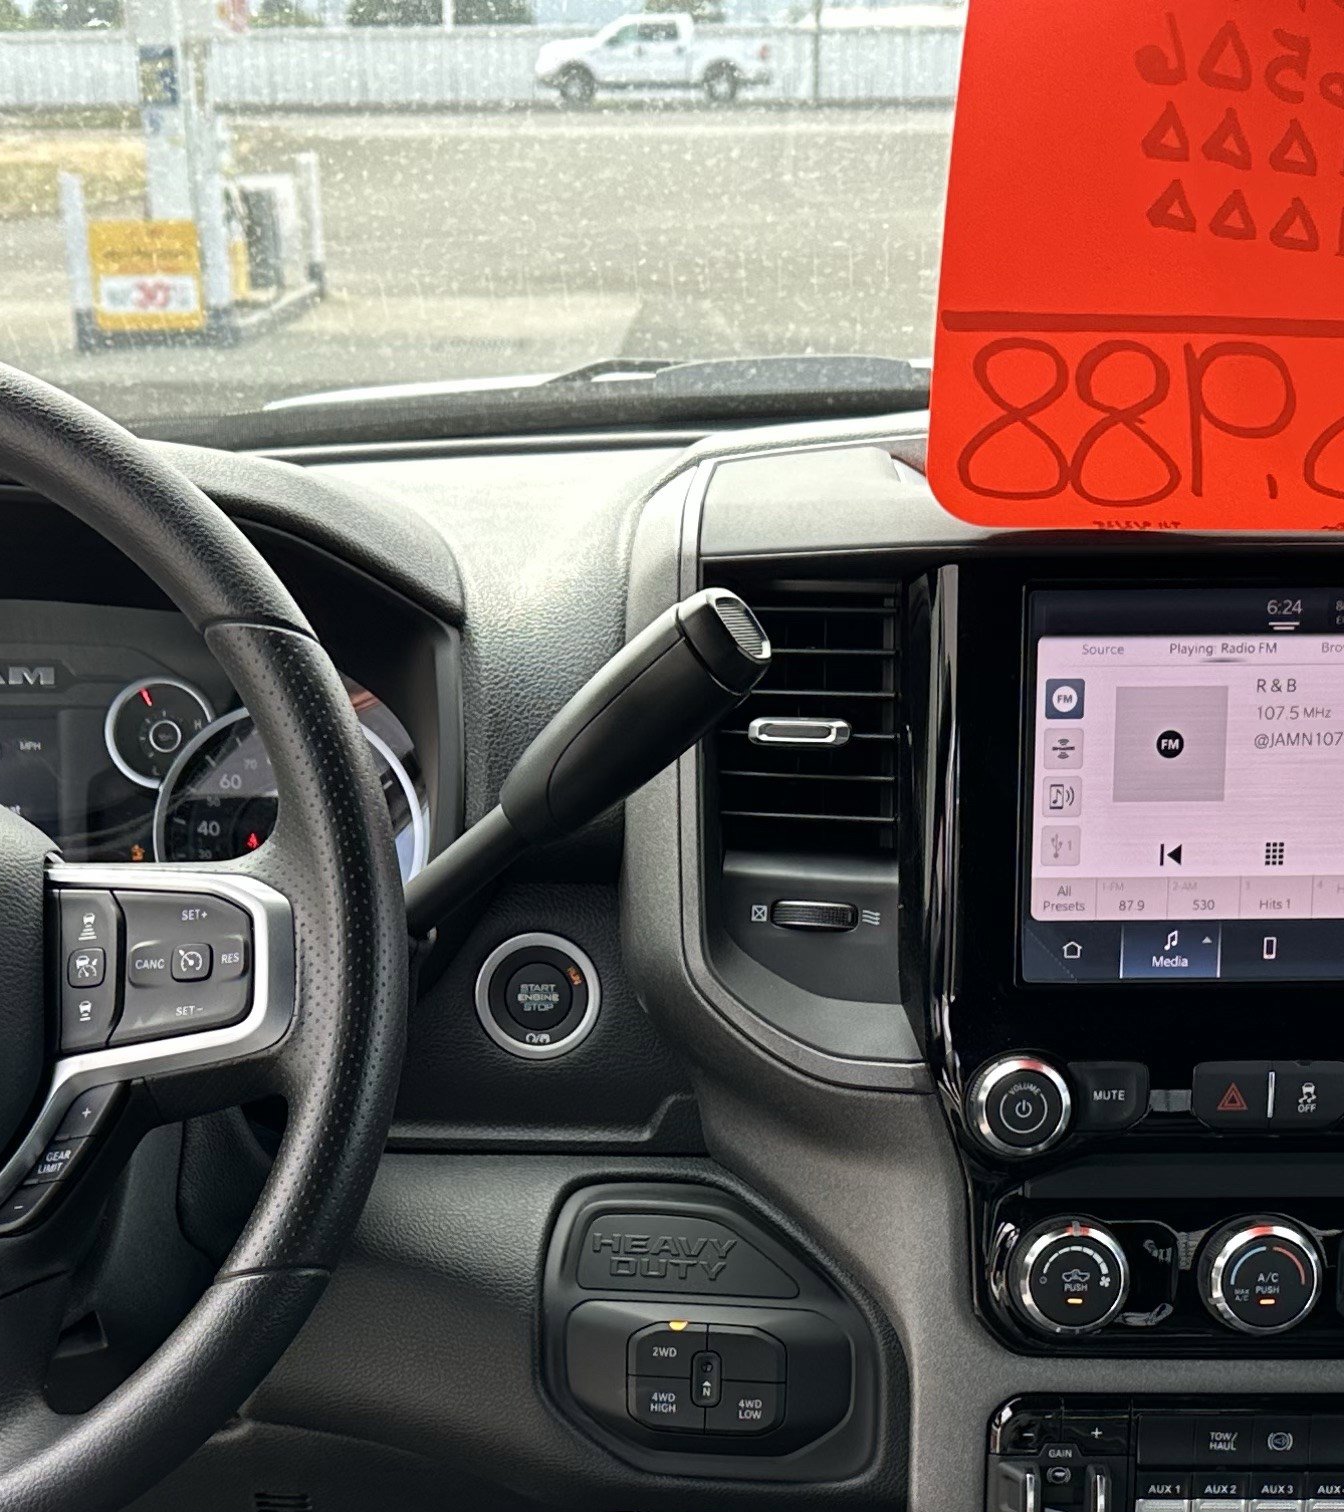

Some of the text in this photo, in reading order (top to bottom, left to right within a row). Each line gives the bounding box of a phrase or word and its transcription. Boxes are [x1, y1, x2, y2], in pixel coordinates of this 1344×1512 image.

[1267, 599, 1303, 615] 6:24
[1082, 643, 1125, 656] Source
[1221, 642, 1256, 655] Radio
[1258, 642, 1278, 654] FM
[1256, 679, 1297, 693] R & B
[1056, 694, 1073, 704] FM
[1257, 706, 1332, 720] 107.5 MHz
[19, 740, 42, 751] MPH
[1160, 739, 1180, 751] FM
[219, 773, 242, 790] 60
[197, 820, 221, 837] 40
[1057, 886, 1072, 898] All
[1042, 900, 1086, 912] Presets
[1118, 899, 1145, 912] 87.9
[1192, 899, 1216, 911] 530
[1259, 898, 1283, 910] Hits
[135, 958, 165, 970] CANC
[221, 953, 240, 965] RES
[1151, 956, 1189, 968] Media
[520, 984, 556, 992] START
[517, 993, 559, 1002] ENGINE
[523, 1002, 554, 1012] STOP
[1008, 1082, 1042, 1096] VOLUME
[1093, 1090, 1125, 1101] MUTE
[1297, 1103, 1317, 1114] OFF
[45, 1150, 71, 1162] GEAR
[37, 1162, 65, 1174] LIMIT
[592, 1232, 737, 1258] HEAVY
[609, 1255, 728, 1281] DUTY
[1257, 1272, 1279, 1283] A/C
[1063, 1282, 1088, 1293] PUSH
[1255, 1285, 1280, 1295] PUSH
[652, 1346, 677, 1358] 2WD
[651, 1392, 676, 1403] 4WD
[702, 1386, 711, 1397] N
[649, 1402, 677, 1413] HIGH
[738, 1398, 763, 1410] 4WD
[738, 1408, 762, 1420] LOW
[1209, 1441, 1237, 1451] HAUL
[1048, 1448, 1073, 1459] GAIN
[1148, 1484, 1171, 1494] AUX
[1204, 1484, 1227, 1494] AUX
[1261, 1484, 1284, 1494] AUX
[1317, 1484, 1339, 1494] AUX
